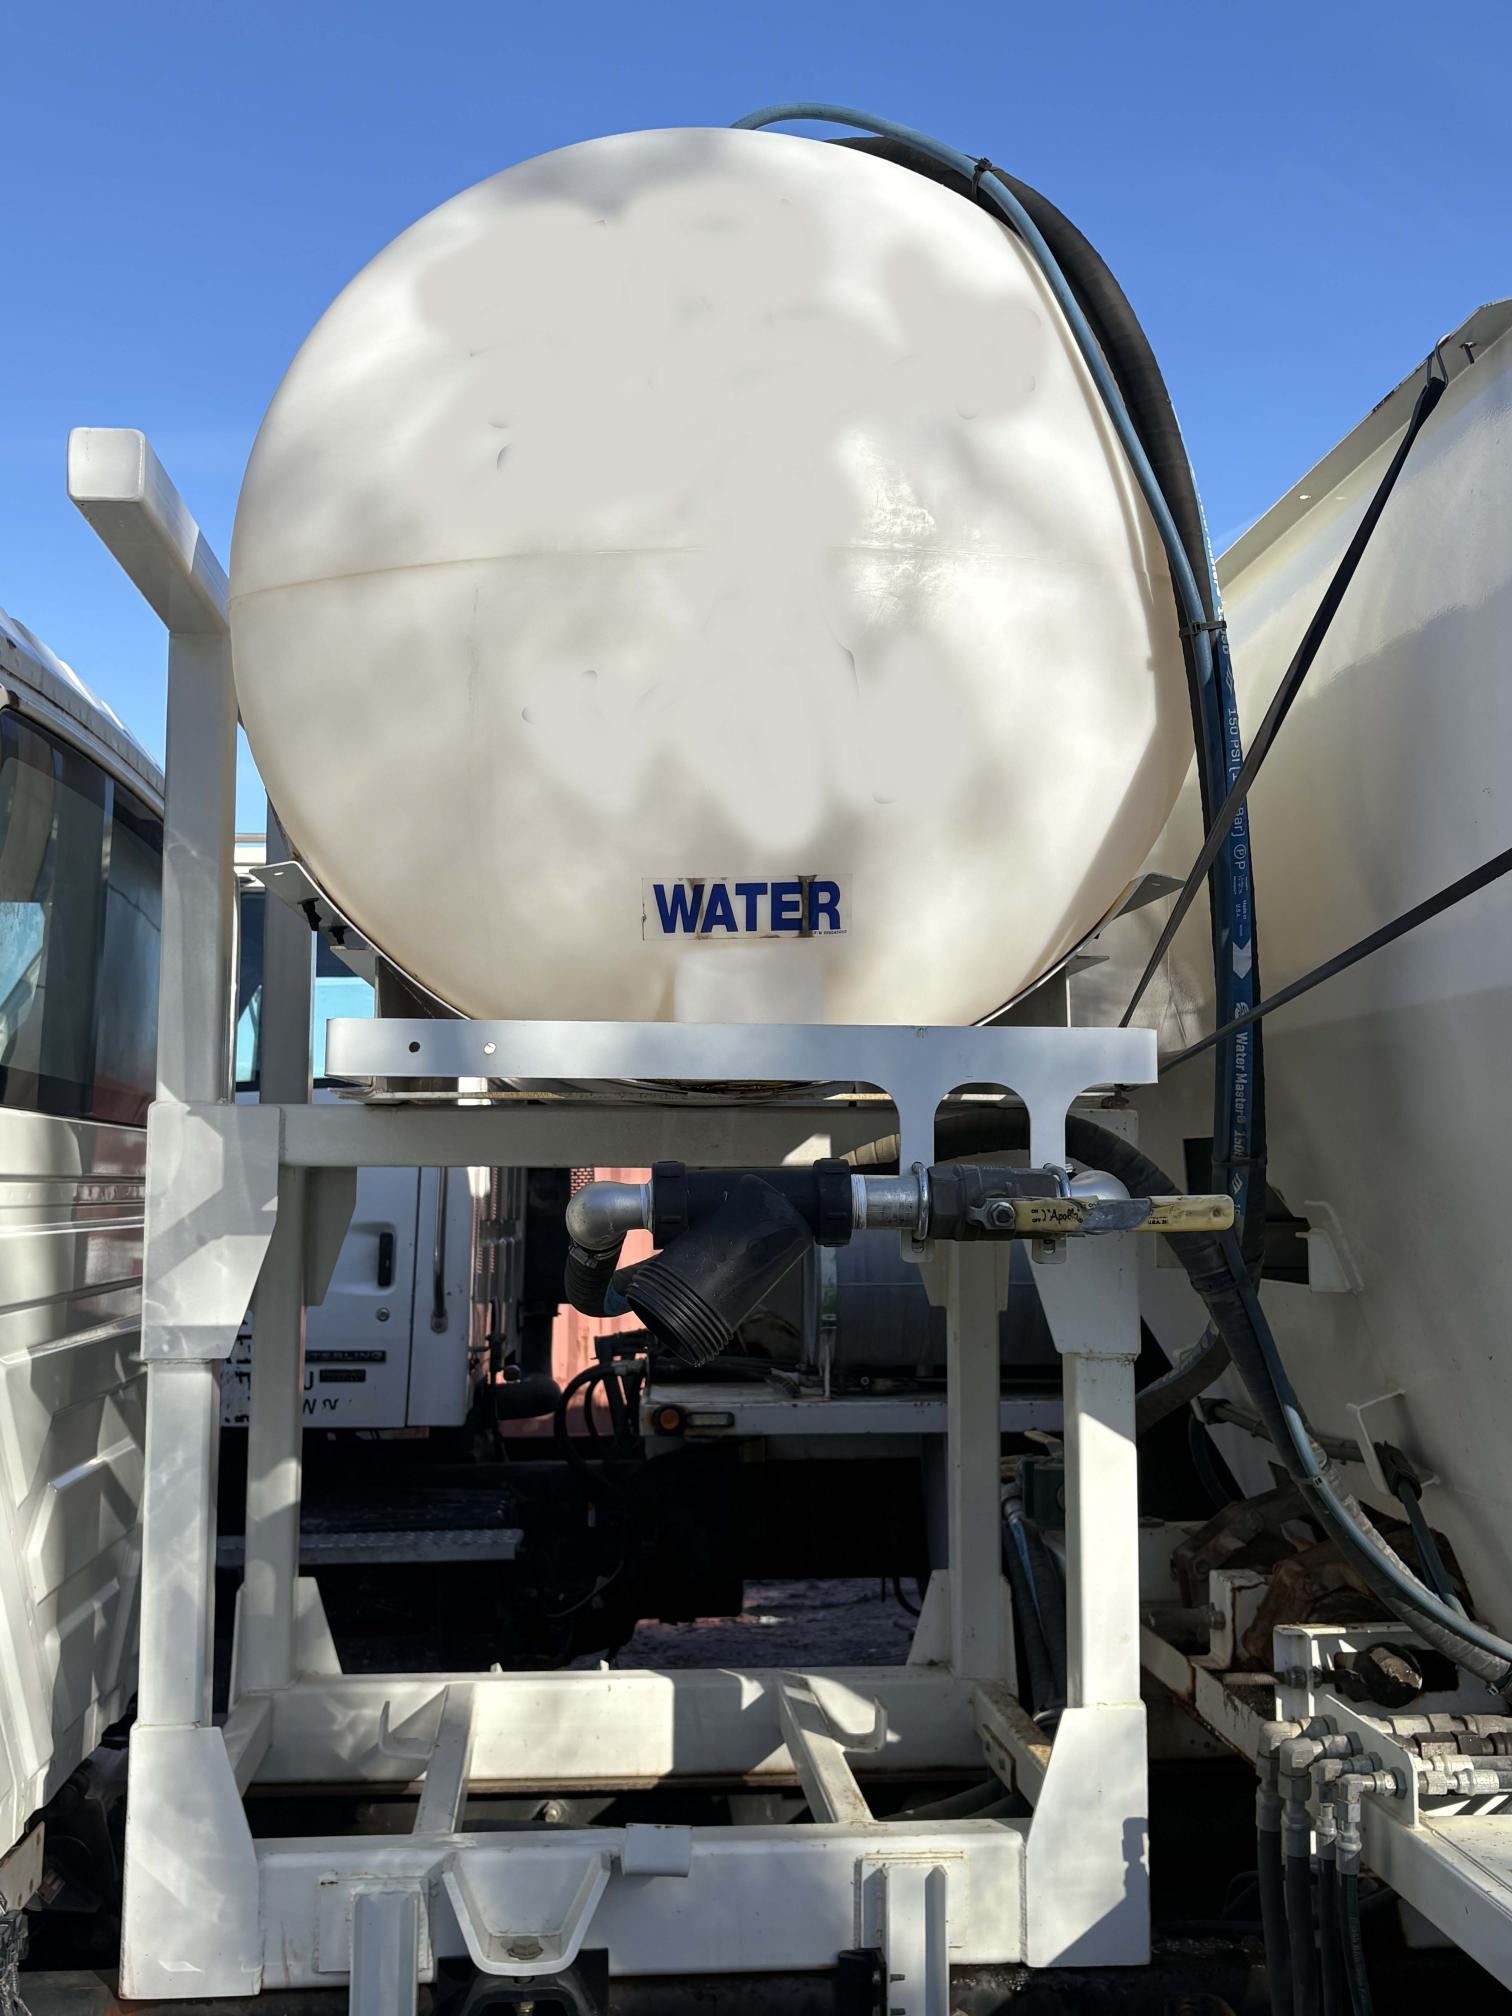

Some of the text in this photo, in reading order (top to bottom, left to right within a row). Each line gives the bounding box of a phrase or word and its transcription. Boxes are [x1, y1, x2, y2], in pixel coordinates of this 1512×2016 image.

[1227, 707, 1239, 735] 150
[1230, 739, 1241, 762] PSI
[653, 880, 841, 934] WATER
[1235, 1031, 1249, 1070] Water
[307, 1350, 383, 1361] TERLING
